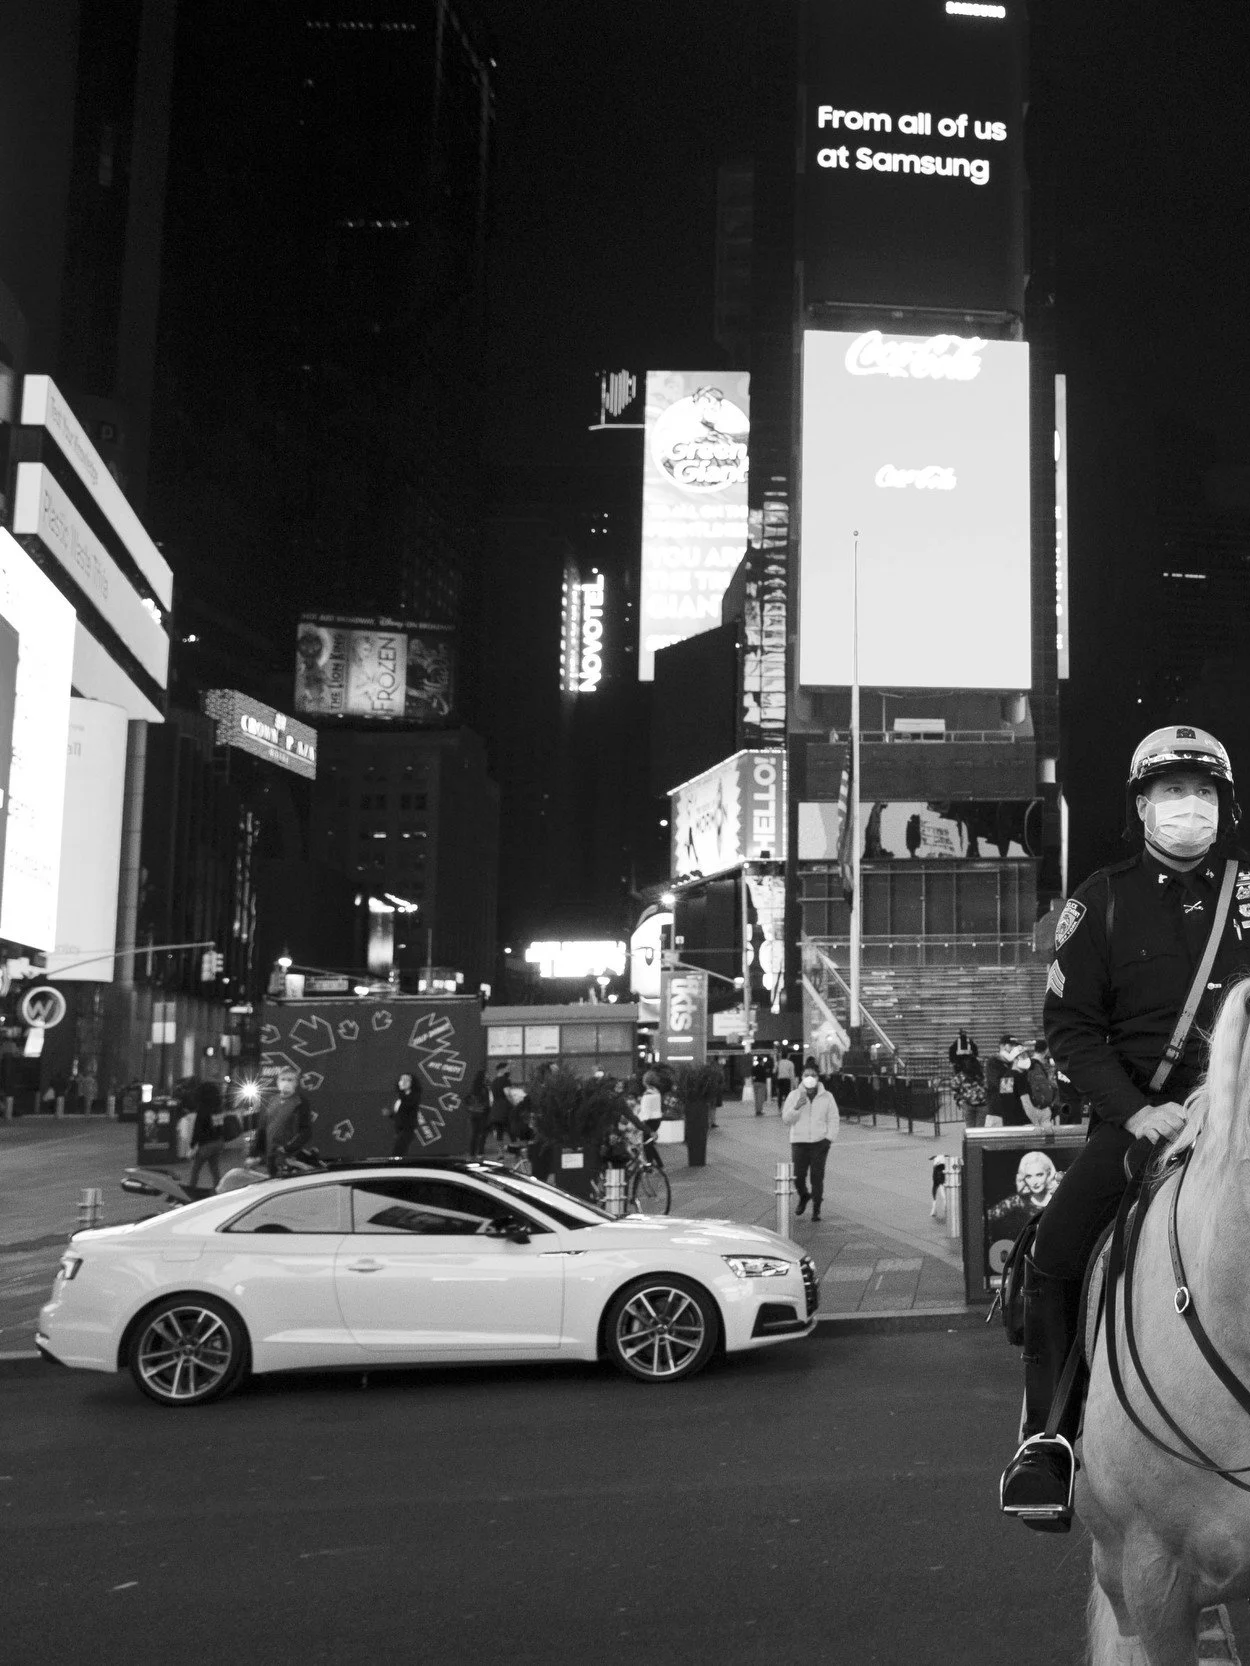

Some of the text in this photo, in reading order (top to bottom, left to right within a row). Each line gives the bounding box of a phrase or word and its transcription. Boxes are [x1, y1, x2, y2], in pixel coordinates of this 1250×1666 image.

[818, 105, 1007, 141] From all of us
[817, 146, 990, 186] at Samsung
[578, 574, 605, 692] NOVOTEL
[371, 636, 399, 713] FROZEN
[752, 757, 777, 859] HELLO!
